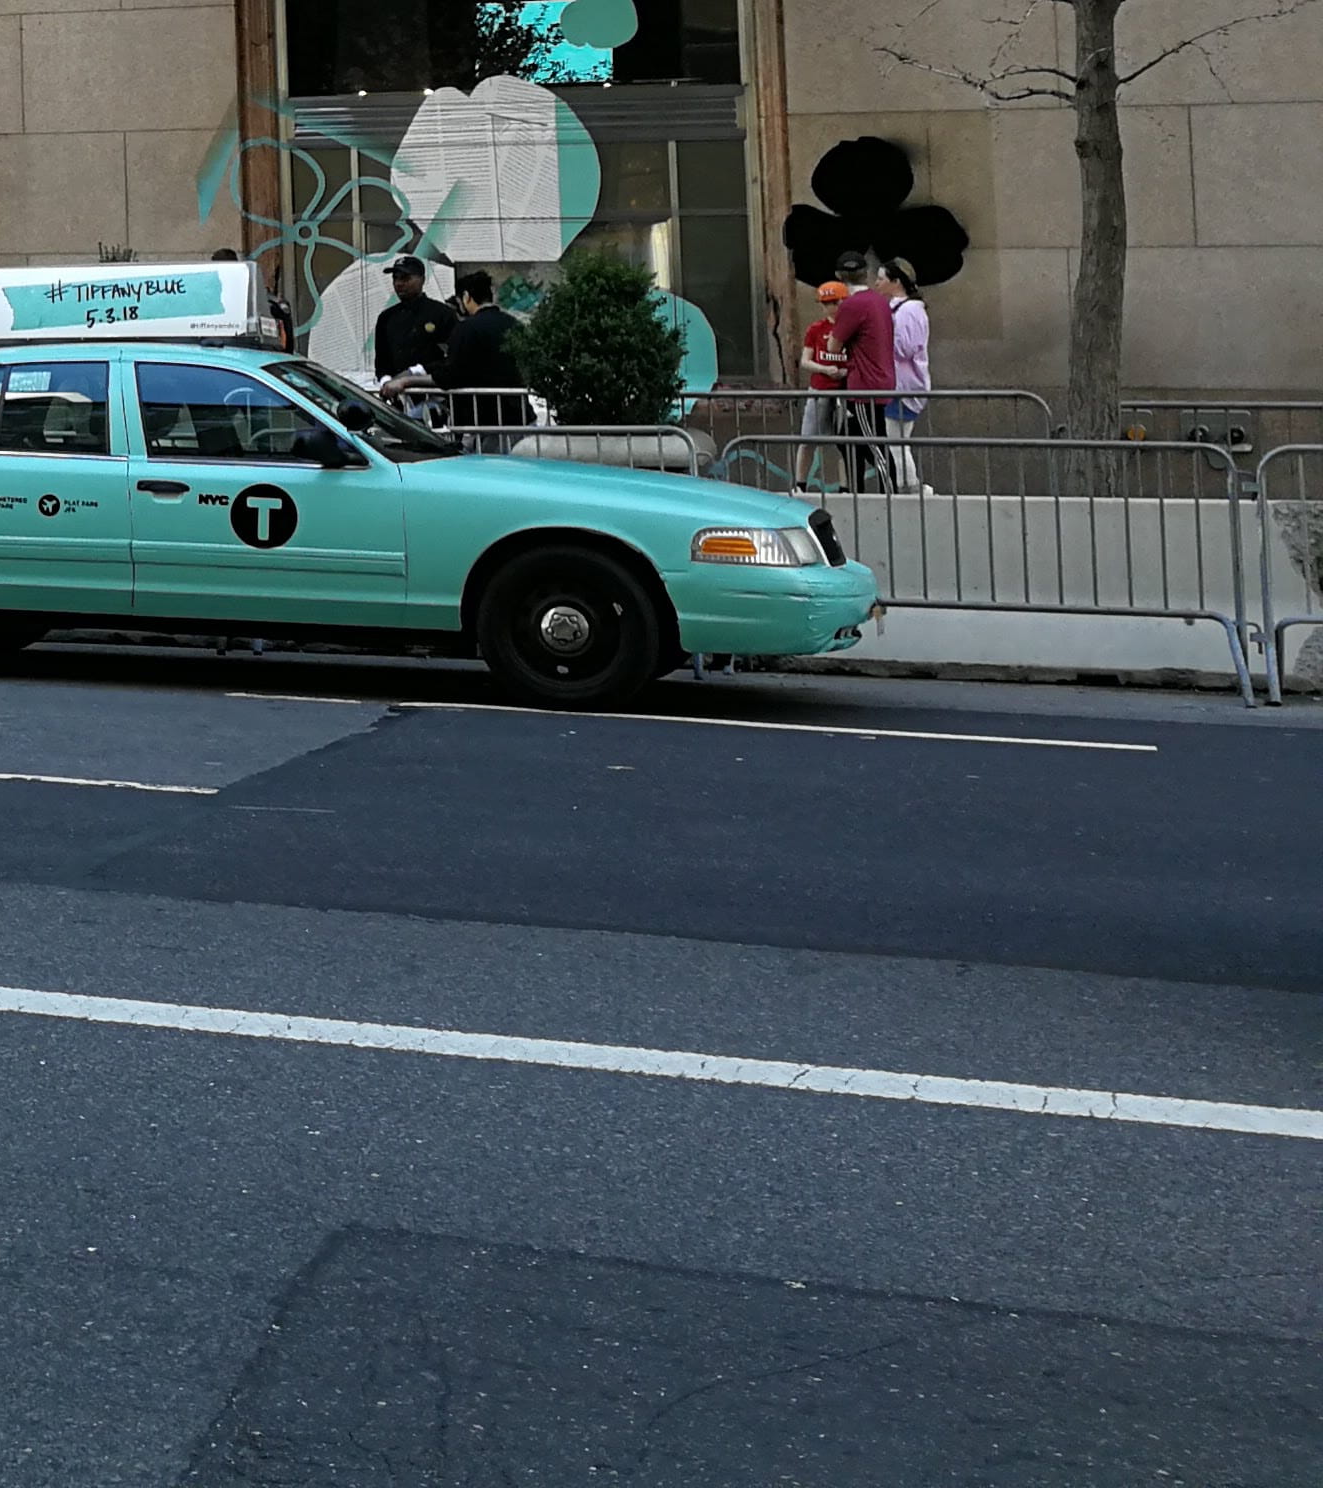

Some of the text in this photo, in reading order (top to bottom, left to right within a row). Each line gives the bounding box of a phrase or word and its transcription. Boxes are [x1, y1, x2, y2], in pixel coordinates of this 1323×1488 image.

[45, 278, 187, 304] #TIFFANYBLUE
[86, 304, 140, 329] 5.3.18
[198, 494, 283, 542] NYC T
